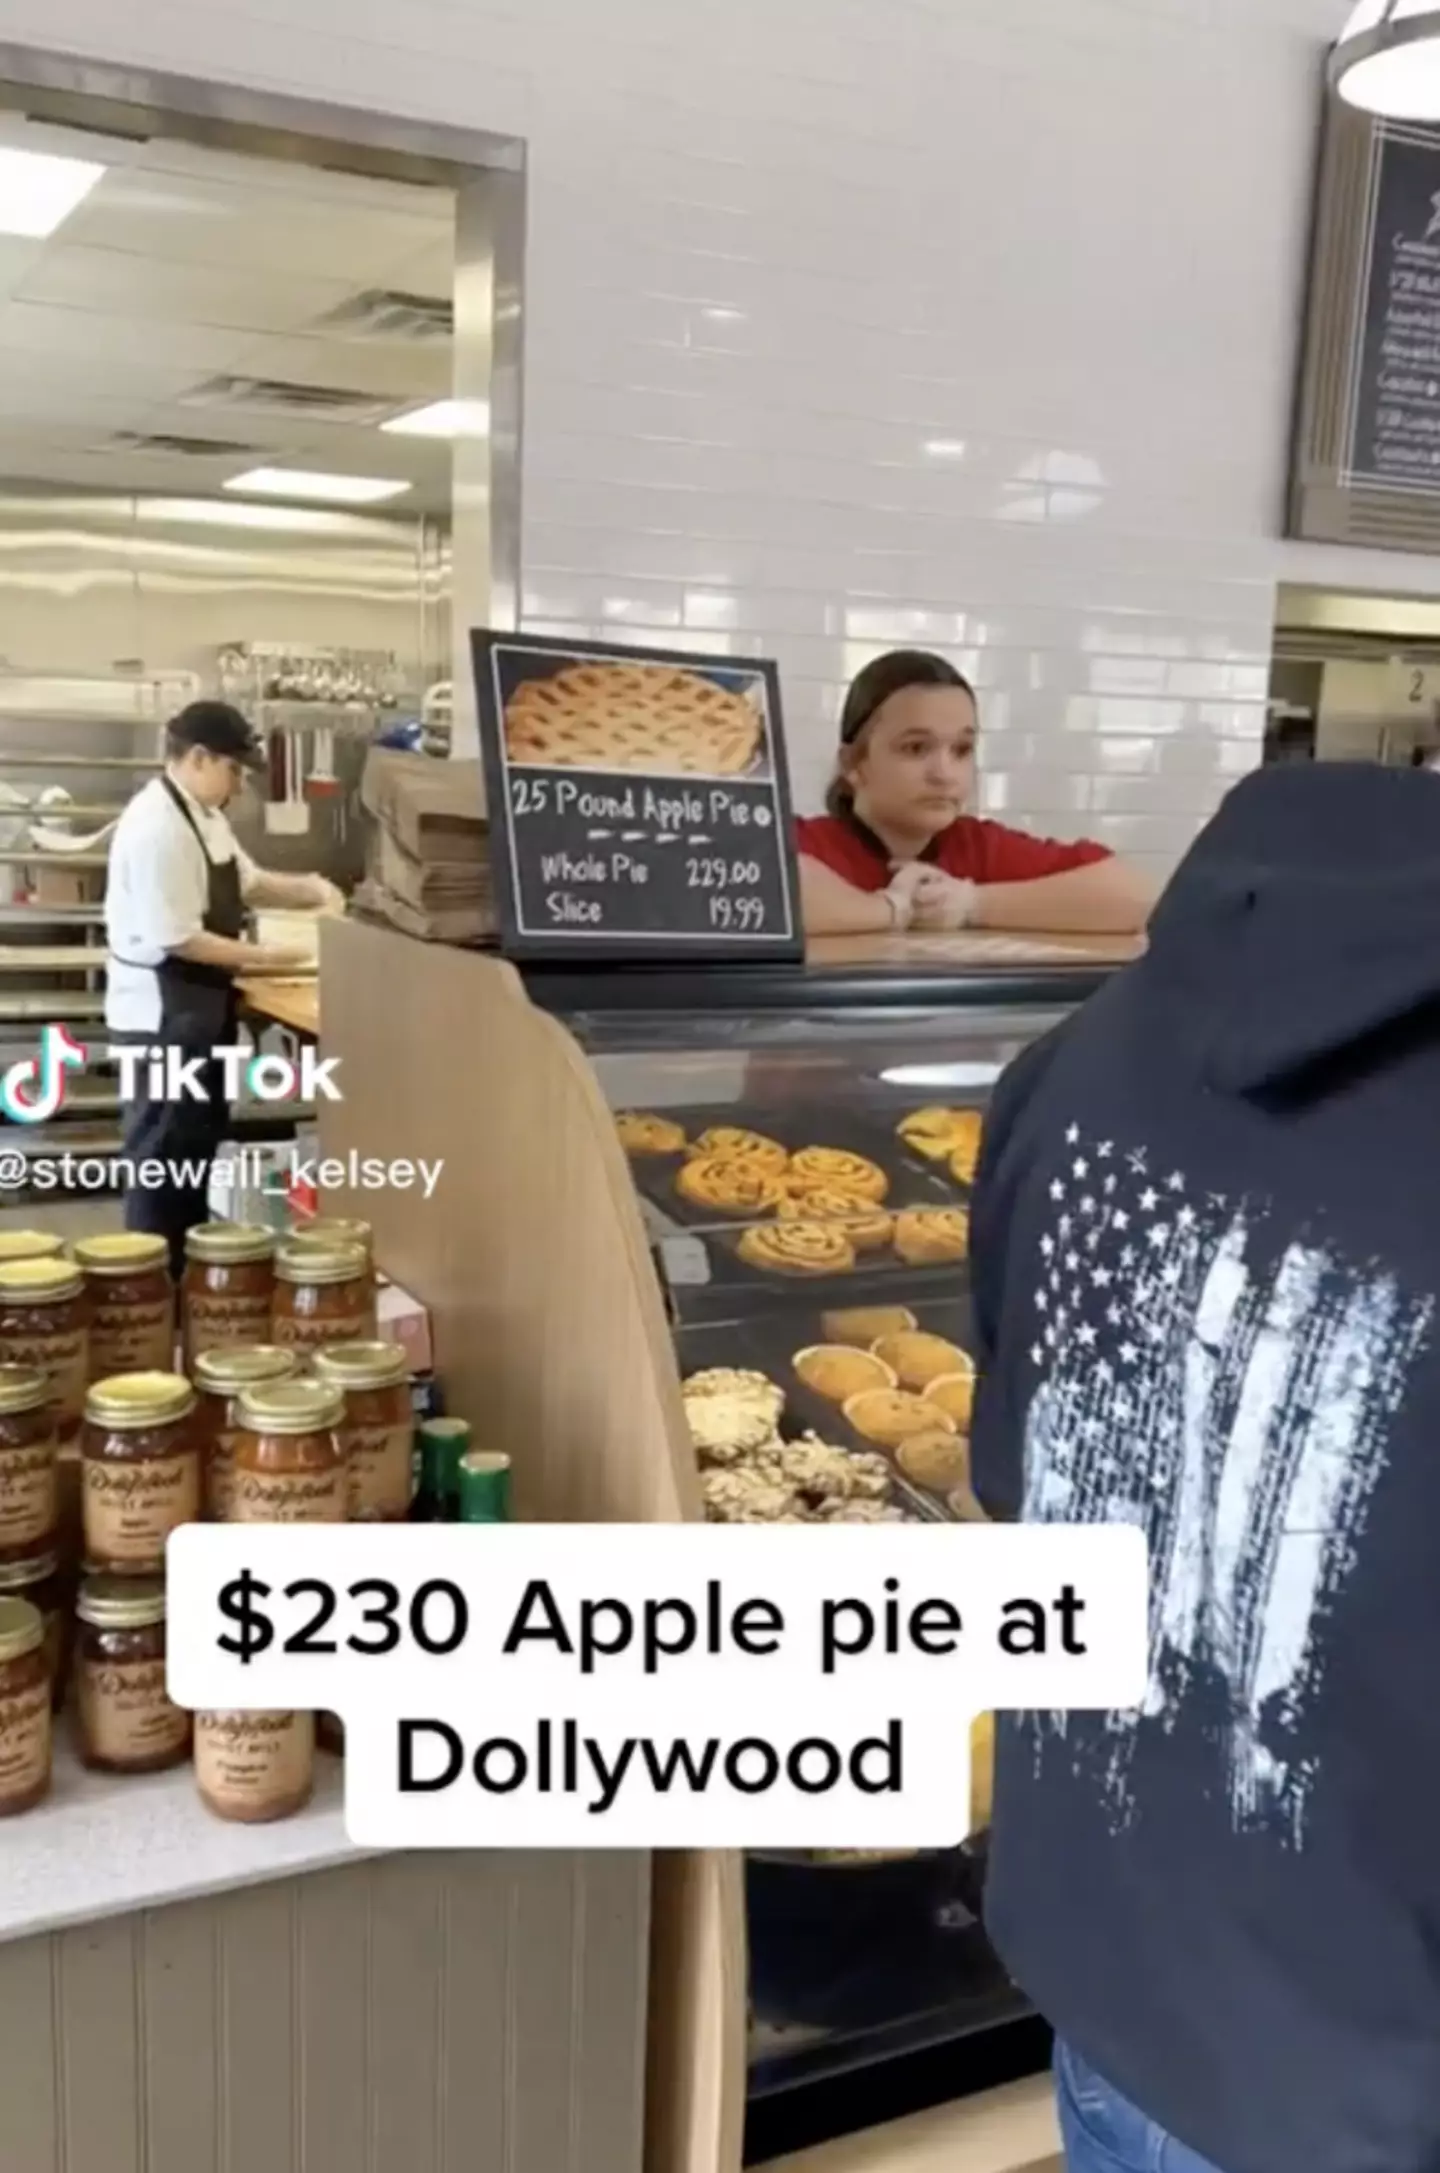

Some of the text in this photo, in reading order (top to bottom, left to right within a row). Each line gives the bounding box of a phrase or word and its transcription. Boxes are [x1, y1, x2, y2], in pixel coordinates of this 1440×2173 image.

[1408, 668, 1425, 702] 2
[511, 779, 749, 829] 25 Pound Apple Pie
[541, 853, 760, 888] Whole Pie 229.00
[546, 892, 765, 929] Slice 19.99
